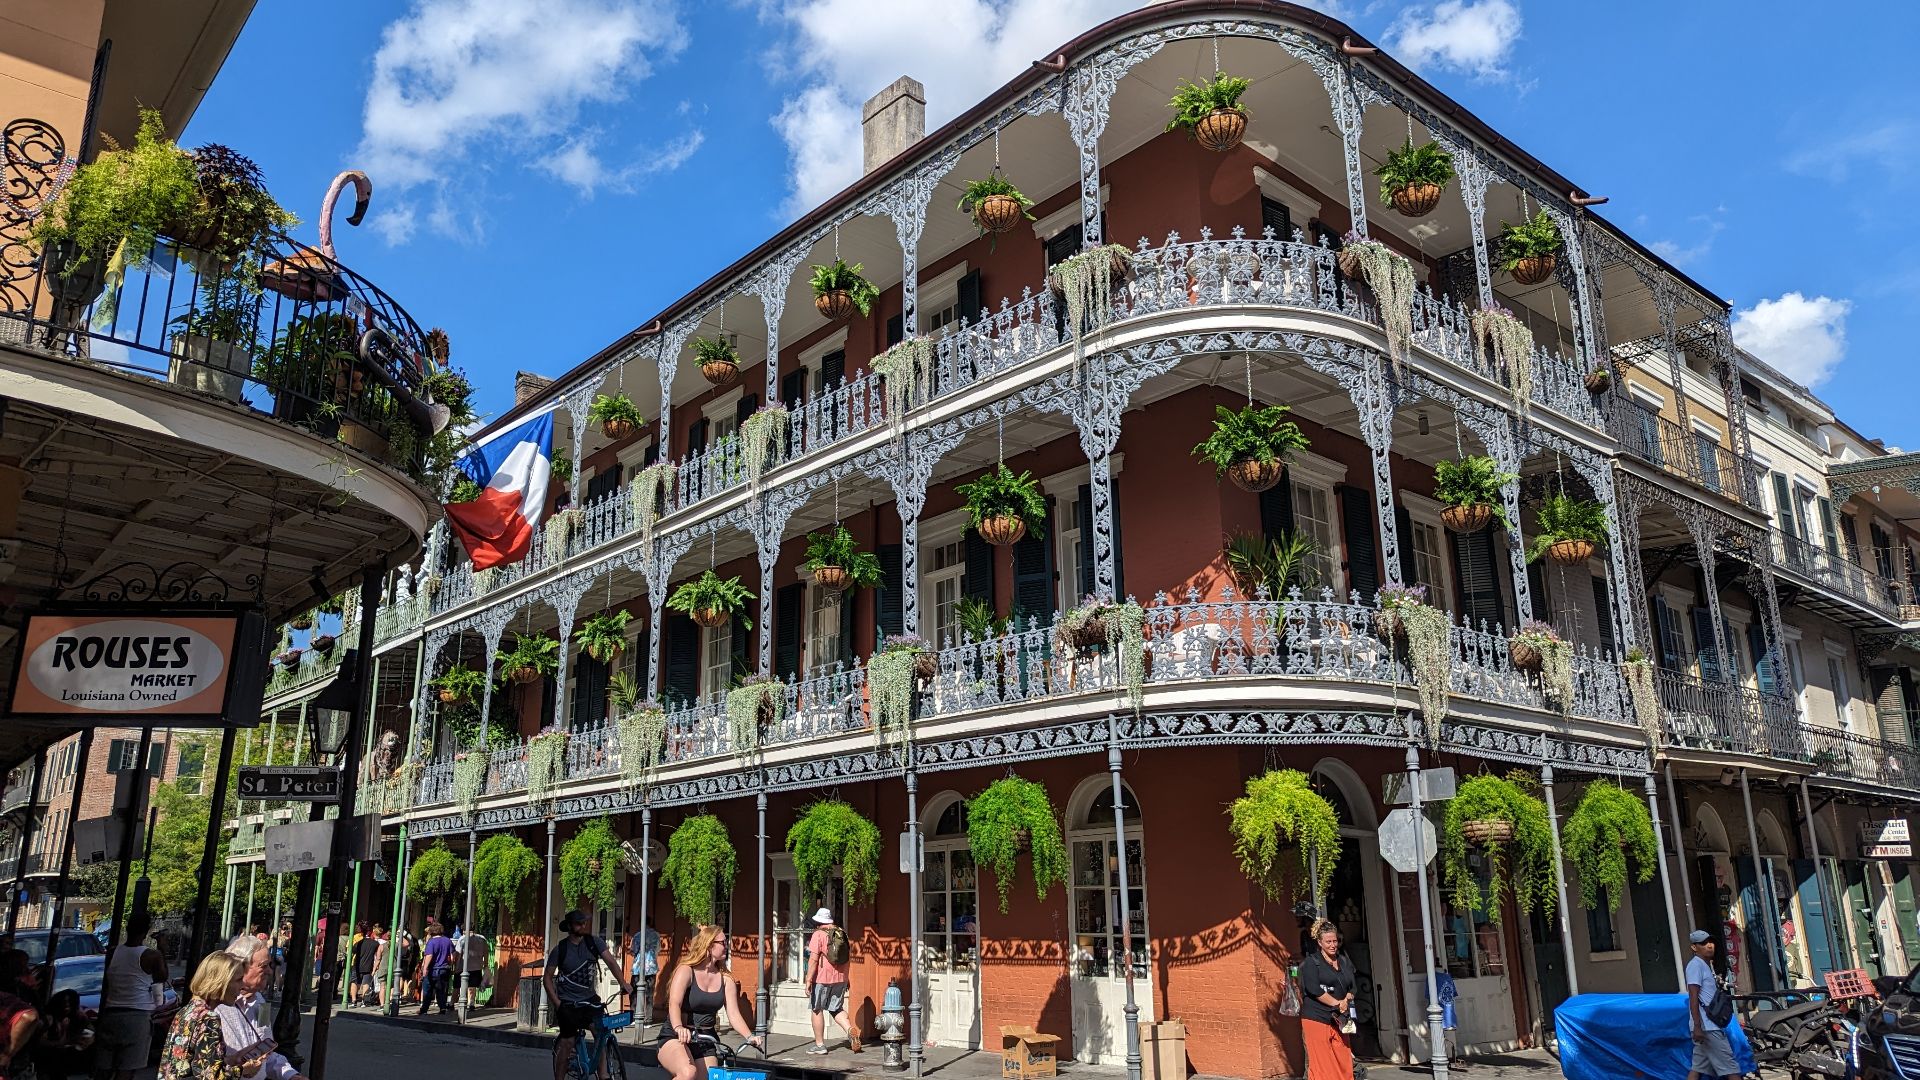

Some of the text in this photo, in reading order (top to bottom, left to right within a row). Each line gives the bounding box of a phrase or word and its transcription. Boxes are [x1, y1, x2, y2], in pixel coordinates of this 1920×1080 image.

[52, 636, 191, 672] ROUSES
[131, 674, 197, 687] MARKET
[62, 689, 177, 701] Louisiana Owned
[280, 775, 334, 792] Peter
[1863, 820, 1905, 828] Discount
[1866, 846, 1889, 855] ATM
